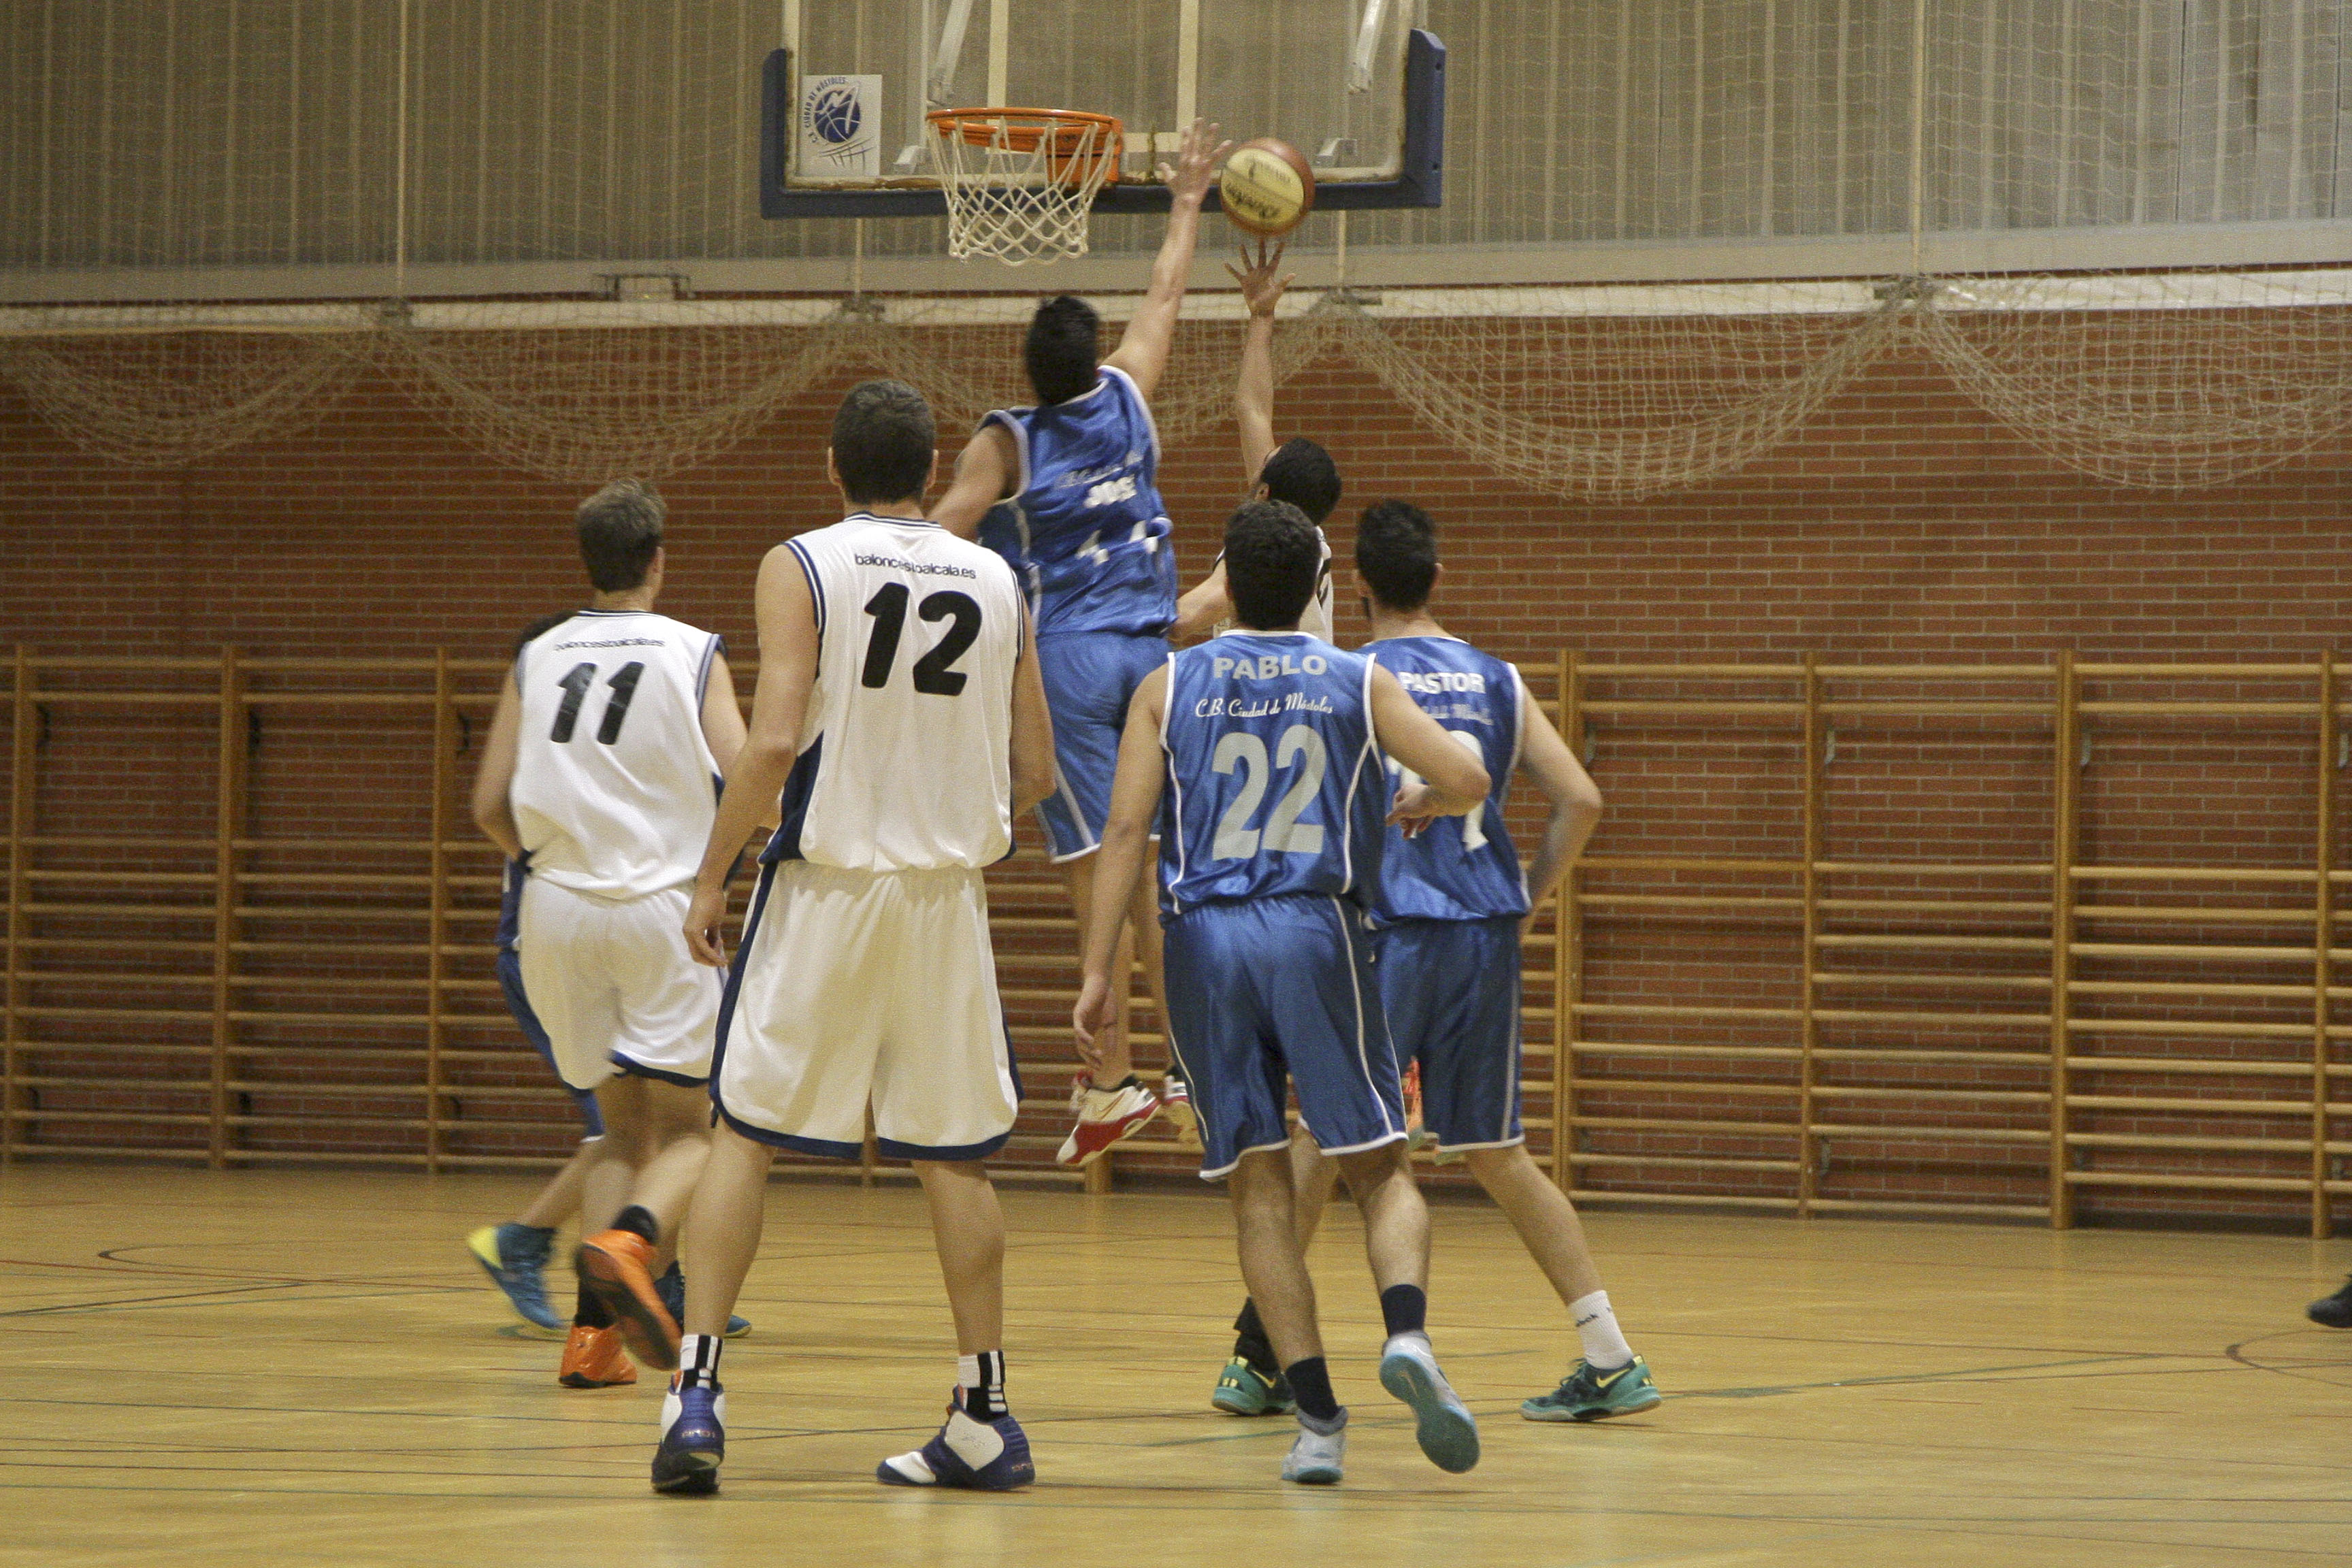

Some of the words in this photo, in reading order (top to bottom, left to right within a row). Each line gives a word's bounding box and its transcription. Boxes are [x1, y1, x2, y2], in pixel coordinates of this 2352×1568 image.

[803, 101, 813, 128] CIUDAD
[862, 582, 982, 696] 12
[1213, 655, 1327, 680] PABLO
[1397, 671, 1486, 694] PASTOR
[550, 661, 645, 745] 11
[1228, 698, 1269, 717] Ciudad
[1269, 698, 1281, 715] de
[1212, 724, 1326, 861] 22
